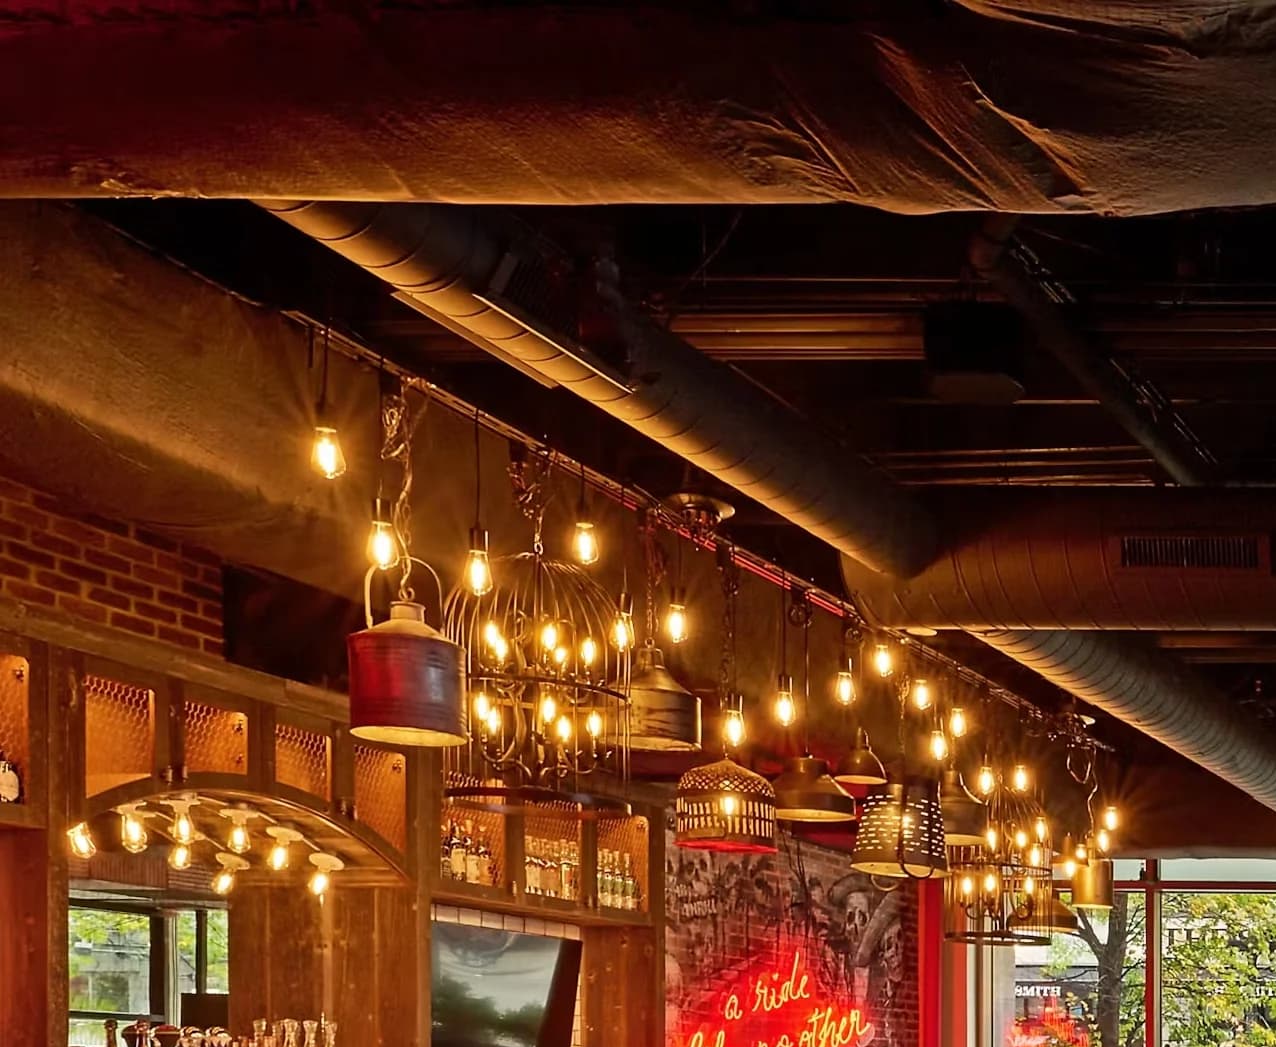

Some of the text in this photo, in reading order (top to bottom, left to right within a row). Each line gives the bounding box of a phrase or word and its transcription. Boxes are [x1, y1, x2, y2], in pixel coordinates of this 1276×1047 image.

[725, 951, 810, 1020] a ride
[1015, 985, 1061, 997] SMITH
